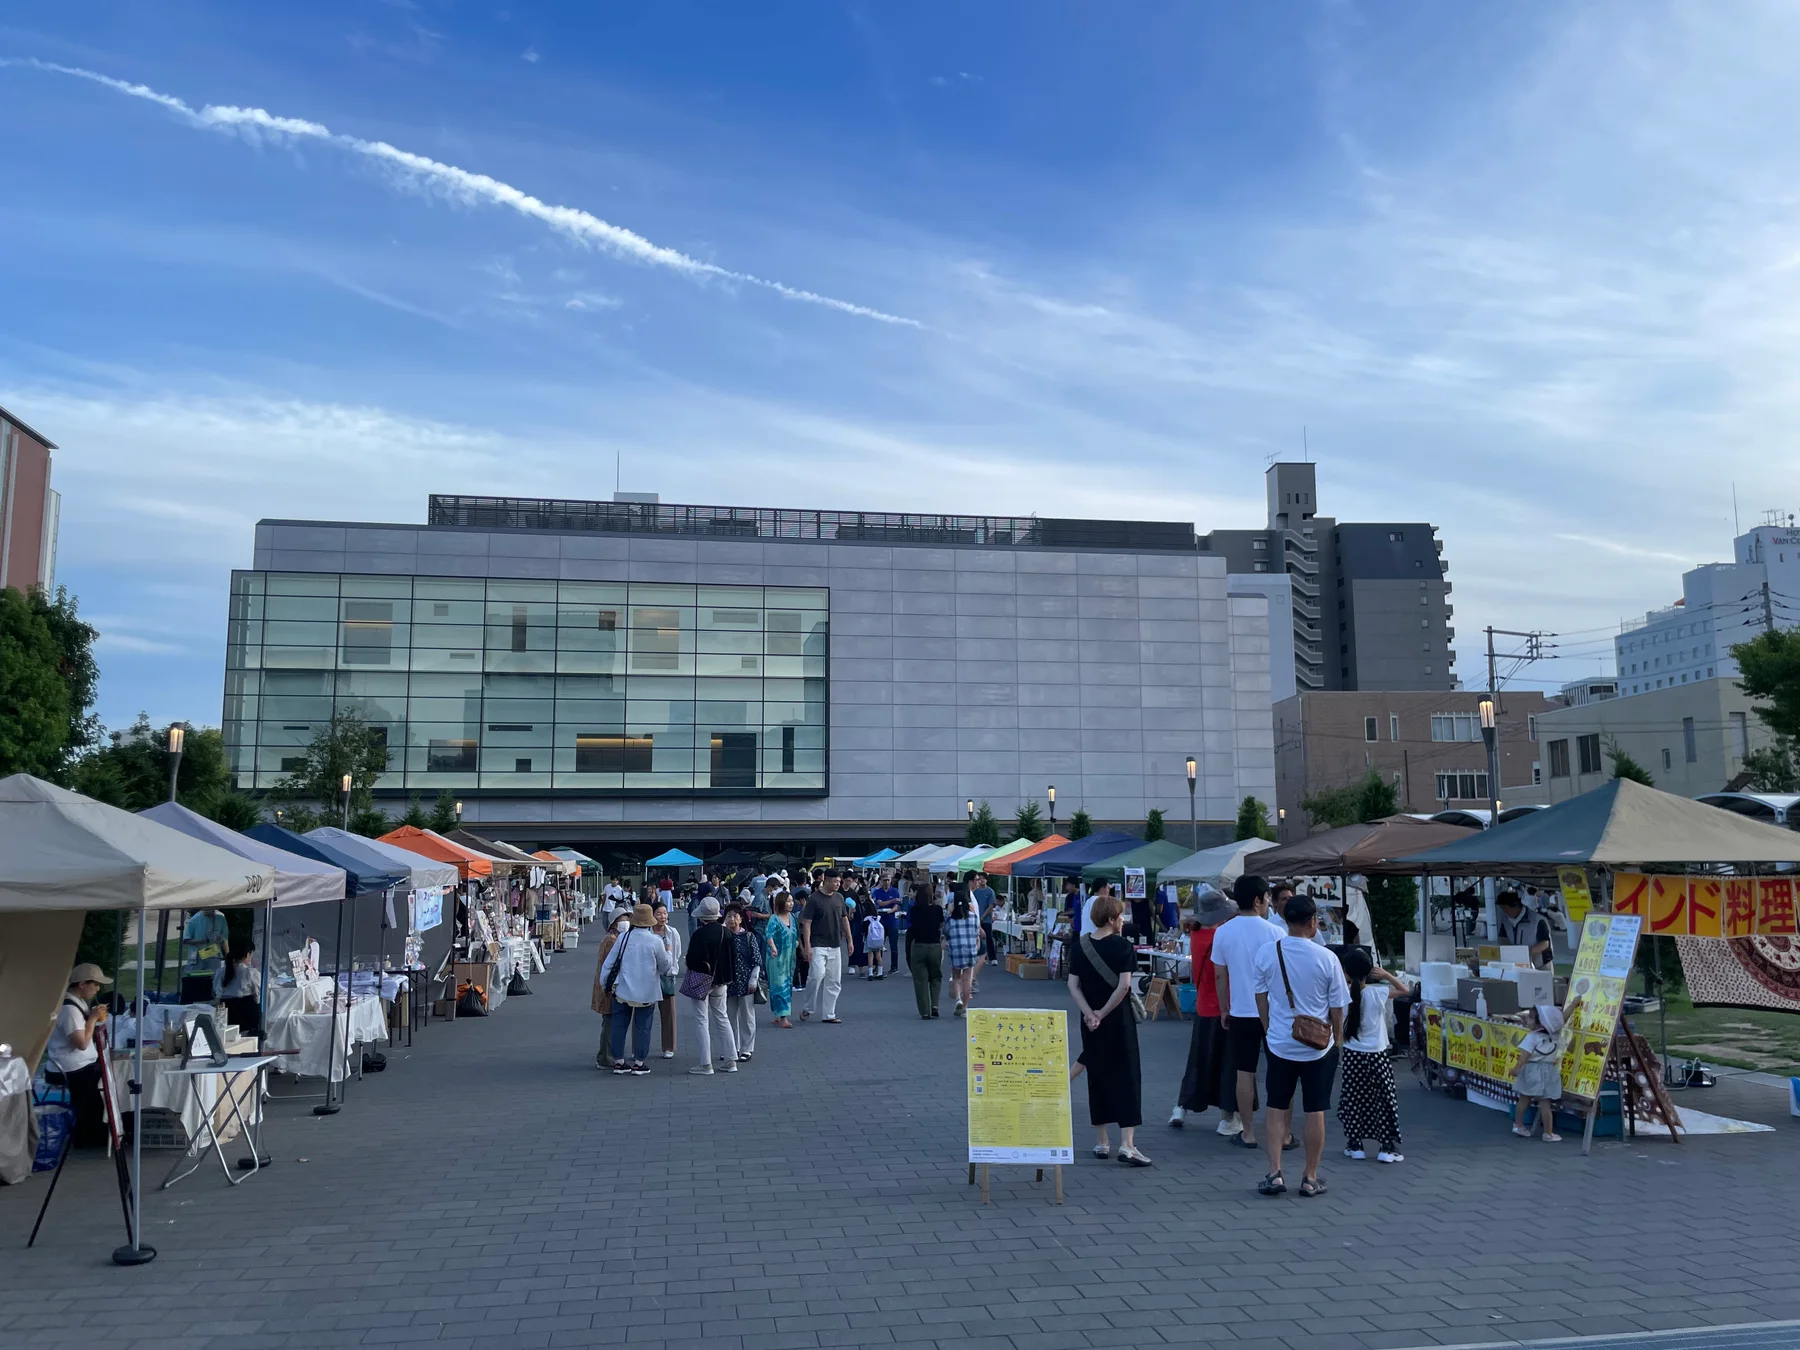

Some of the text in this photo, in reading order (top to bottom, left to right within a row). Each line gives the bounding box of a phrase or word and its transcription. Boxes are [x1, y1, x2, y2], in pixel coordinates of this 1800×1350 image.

[1615, 876, 1800, 935] インド料理
